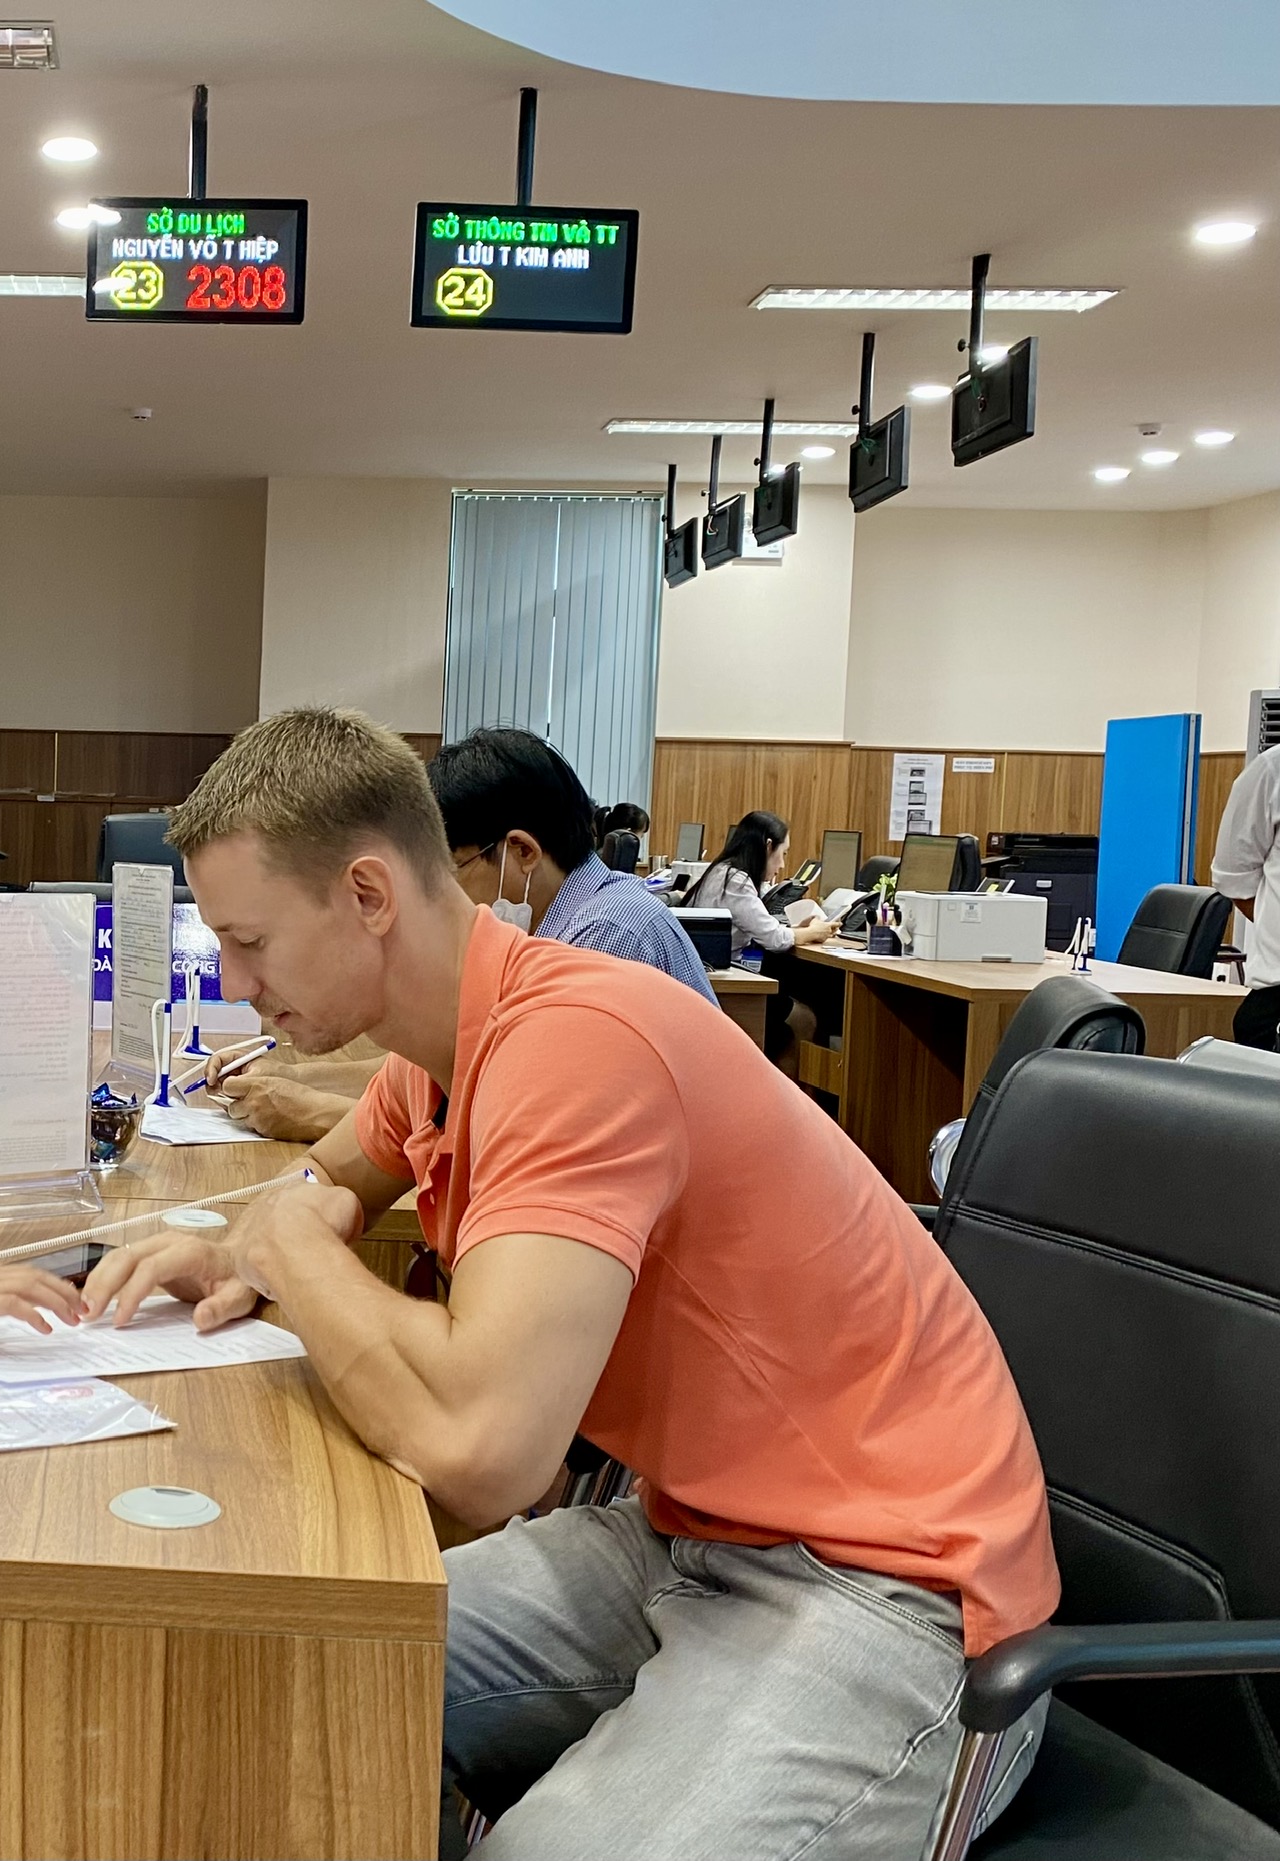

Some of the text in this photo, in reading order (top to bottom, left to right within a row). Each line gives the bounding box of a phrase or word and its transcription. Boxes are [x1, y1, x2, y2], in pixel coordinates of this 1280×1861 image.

[147, 207, 245, 237] SỞ DU LỊCH
[464, 216, 525, 241] THÔNG
[529, 222, 558, 242] TIN
[595, 225, 619, 245] TT
[112, 234, 184, 260] NGUYỄN
[222, 239, 235, 260] T
[239, 235, 279, 263] HIỆP
[499, 246, 512, 267] T
[516, 246, 549, 268] KIM
[553, 248, 590, 269] ANH
[116, 264, 286, 310] 23 2308
[444, 275, 486, 306] 24
